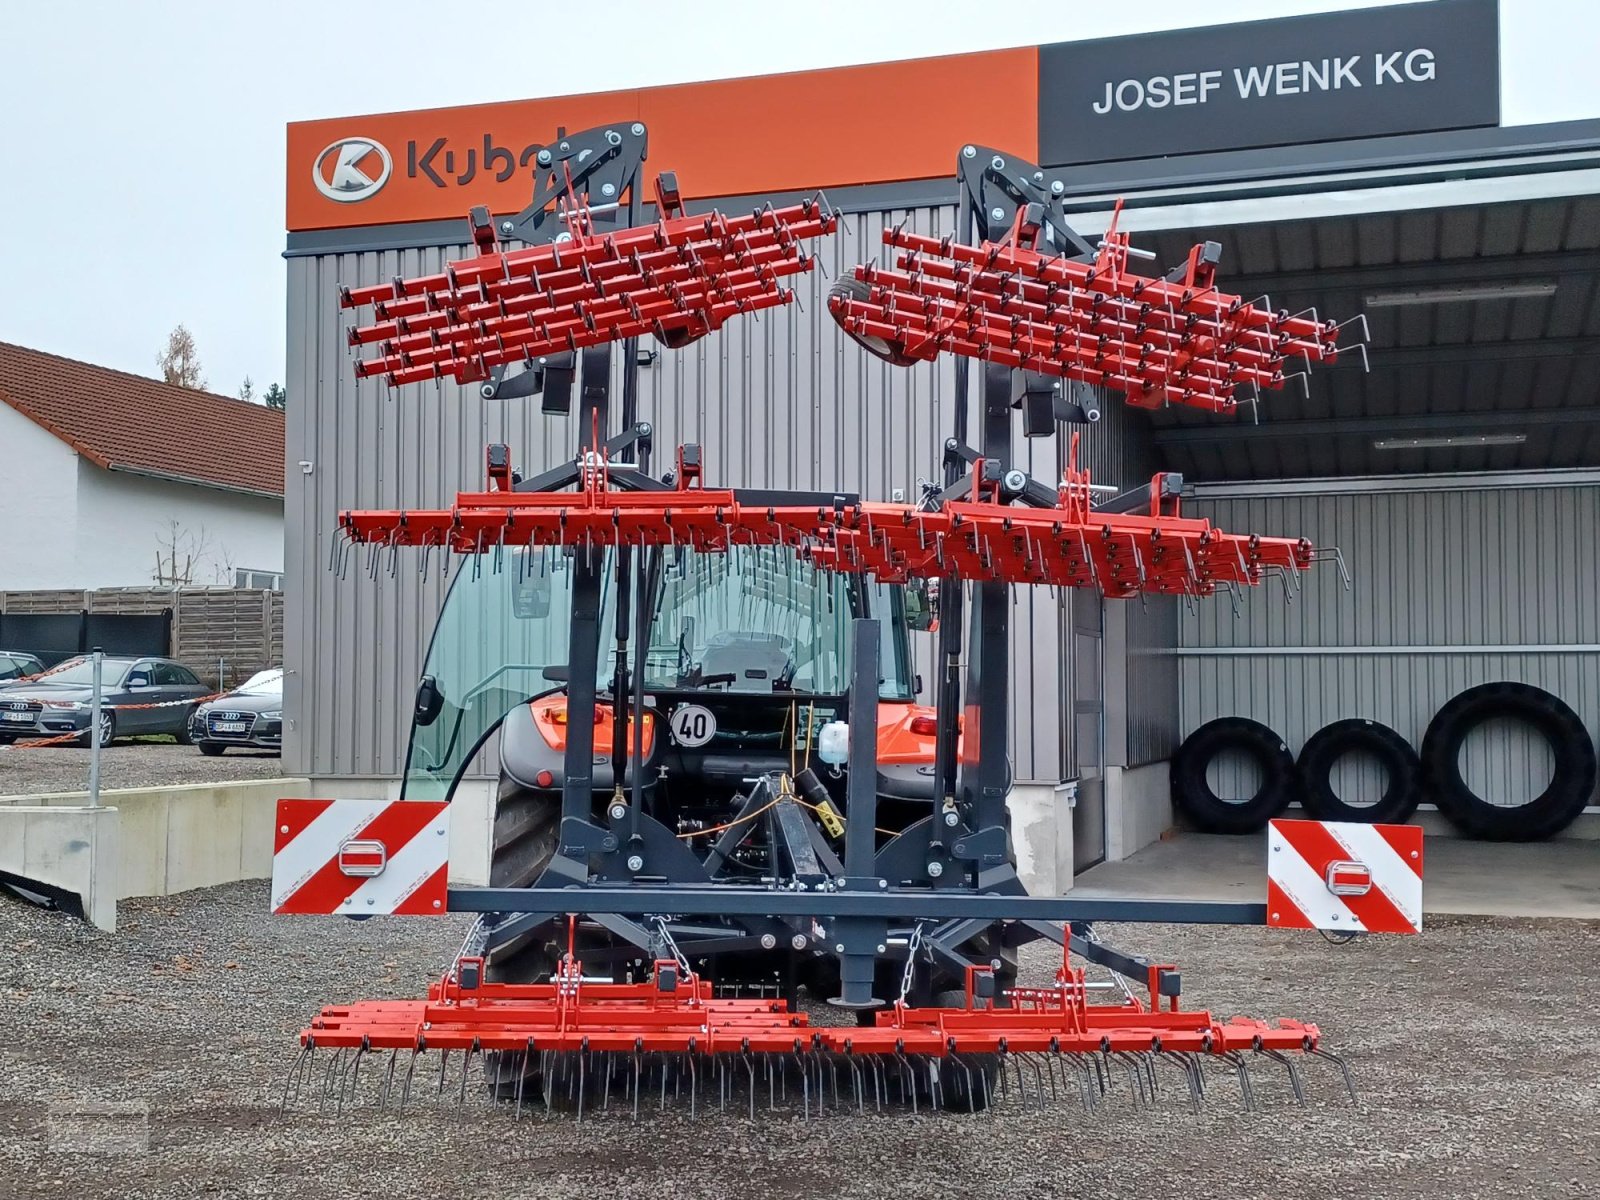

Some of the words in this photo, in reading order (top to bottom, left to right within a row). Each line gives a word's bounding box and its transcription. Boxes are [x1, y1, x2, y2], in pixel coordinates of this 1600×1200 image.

[1092, 70, 1222, 114] JOSEF
[1233, 55, 1362, 99] WENK
[1375, 48, 1436, 85] KG
[679, 713, 707, 739] 40
